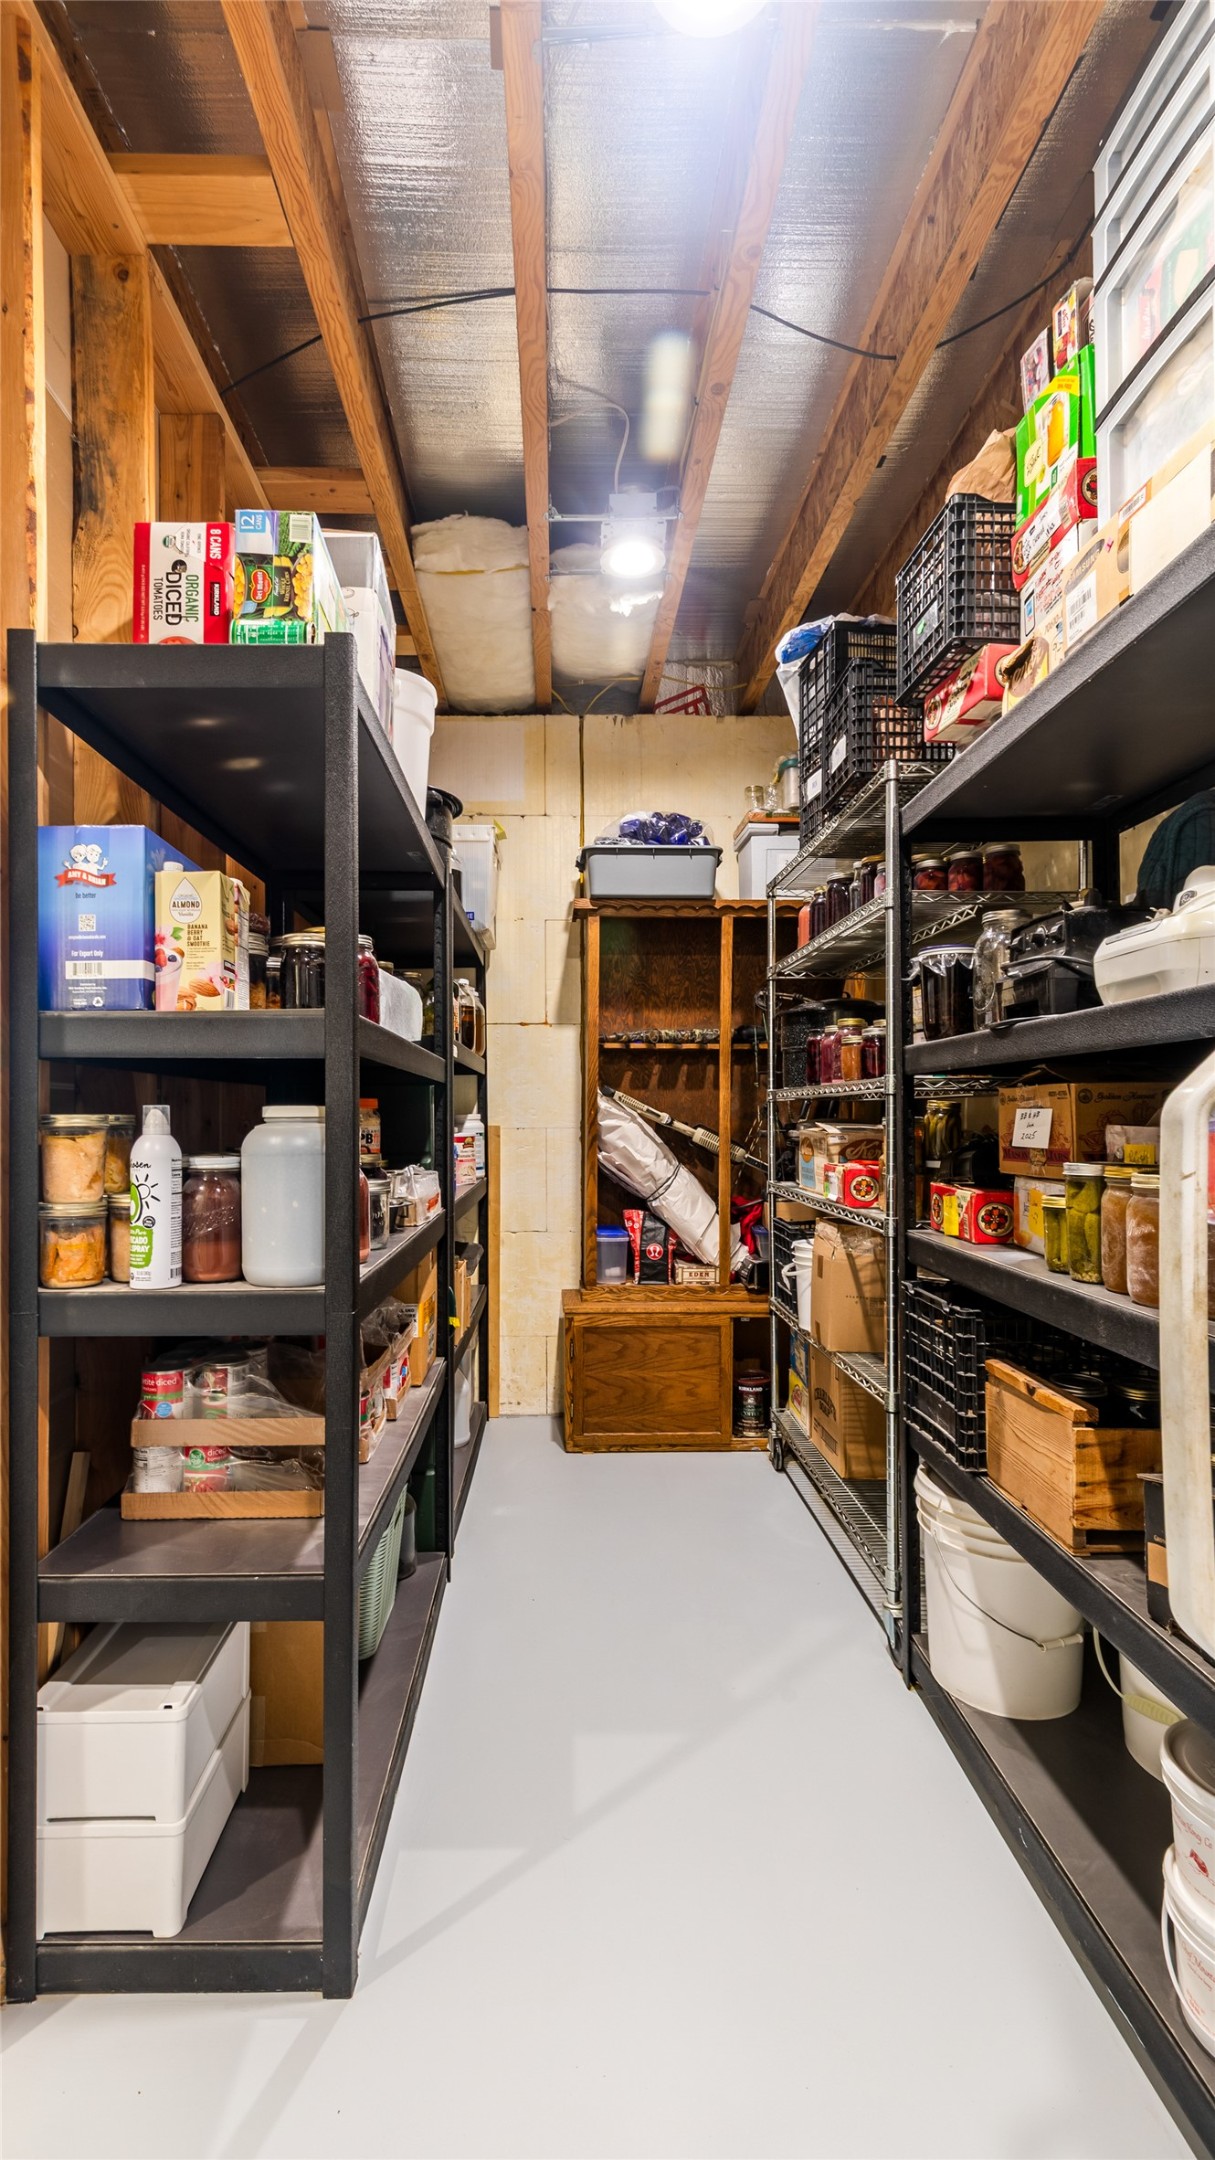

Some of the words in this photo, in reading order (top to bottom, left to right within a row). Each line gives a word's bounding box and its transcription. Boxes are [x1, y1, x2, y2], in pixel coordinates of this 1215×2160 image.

[240, 514, 255, 530] 12
[209, 535, 222, 560] CANS
[153, 577, 164, 621] TOMATOES
[165, 572, 183, 626] DICED
[185, 574, 200, 623] ORGANIC
[255, 590, 263, 600] Del
[67, 870, 81, 879] AMY
[172, 901, 201, 909] ALMOND
[79, 950, 93, 958] Export
[94, 950, 104, 958] Only
[1021, 1130, 1036, 1140] 2025
[155, 1377, 177, 1387] diced
